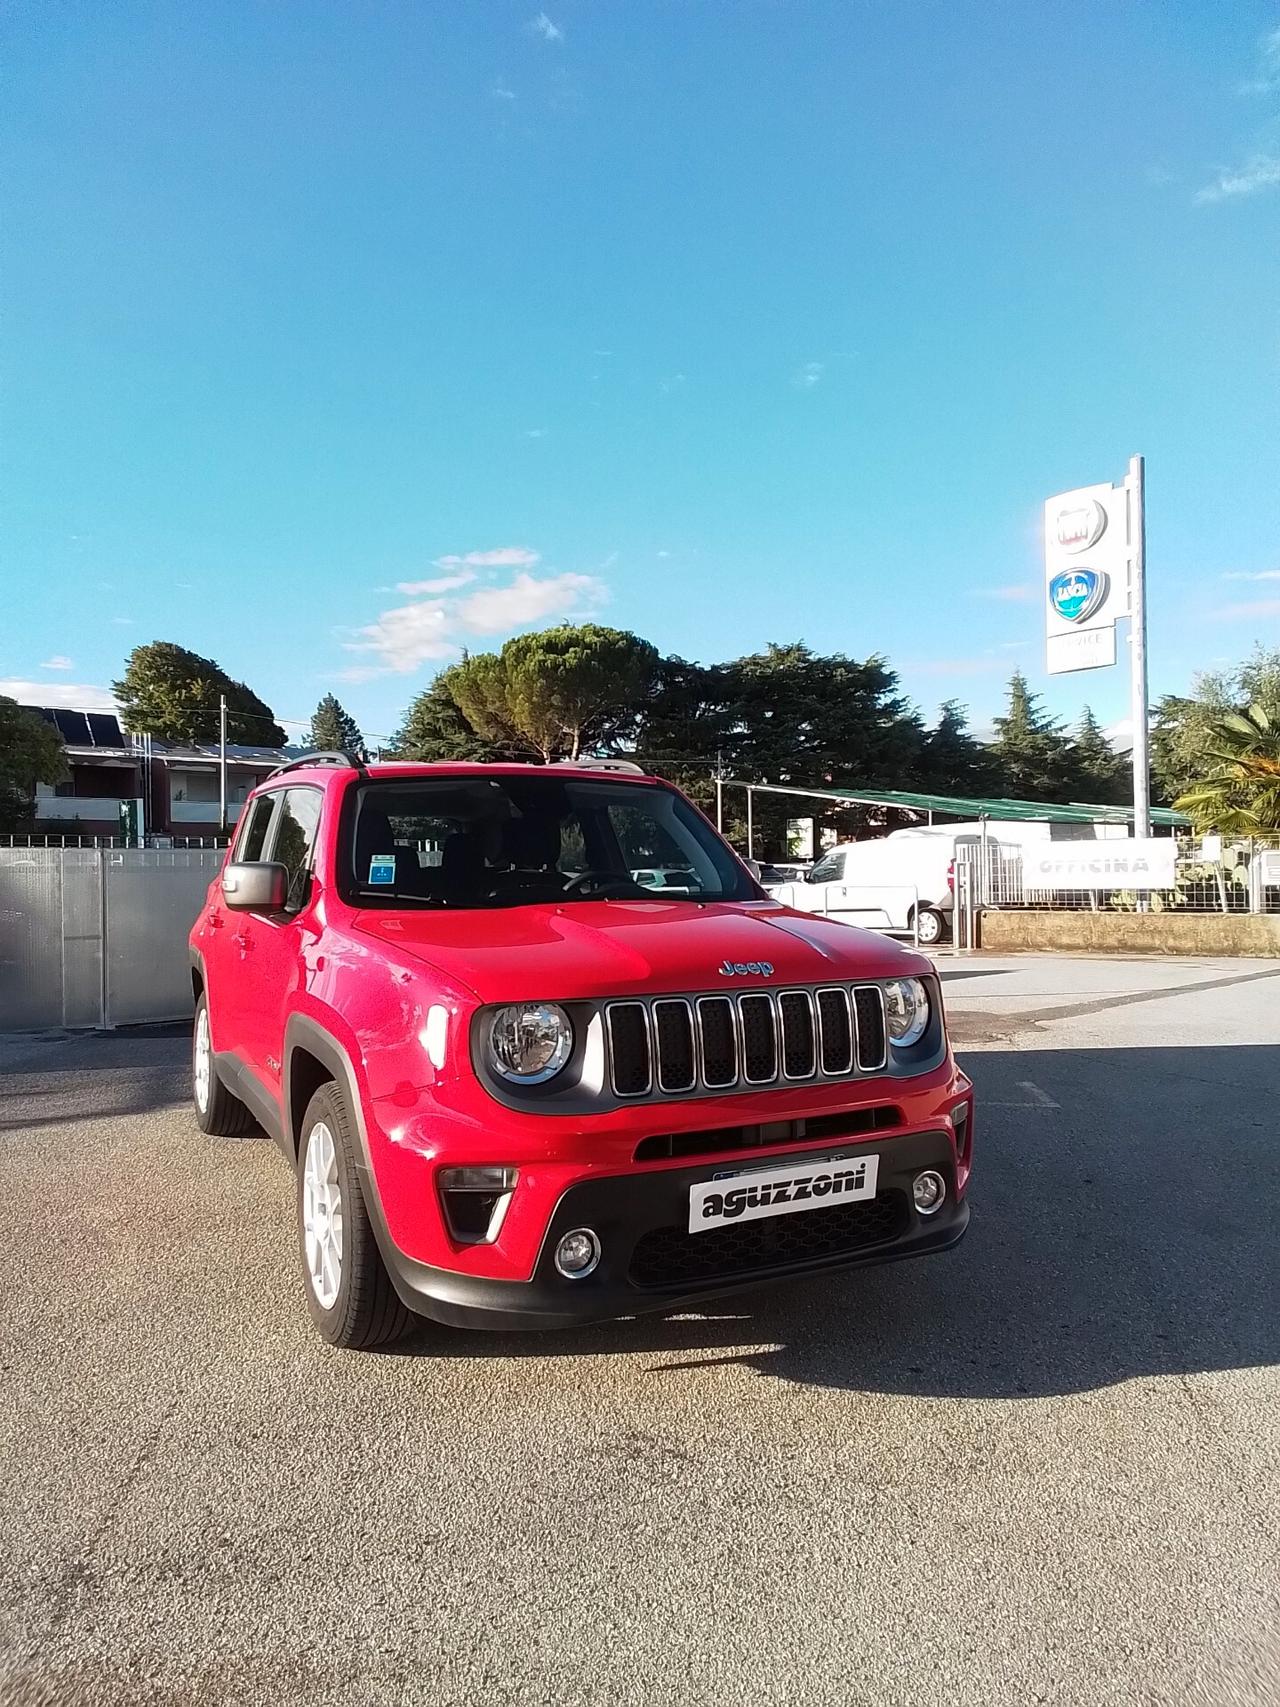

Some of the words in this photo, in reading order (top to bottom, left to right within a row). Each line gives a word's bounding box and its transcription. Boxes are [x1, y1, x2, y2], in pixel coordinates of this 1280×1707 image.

[1039, 857, 1149, 874] OFFICINA
[718, 959, 775, 978] Jeep
[702, 1162, 867, 1218] aguzzoni
